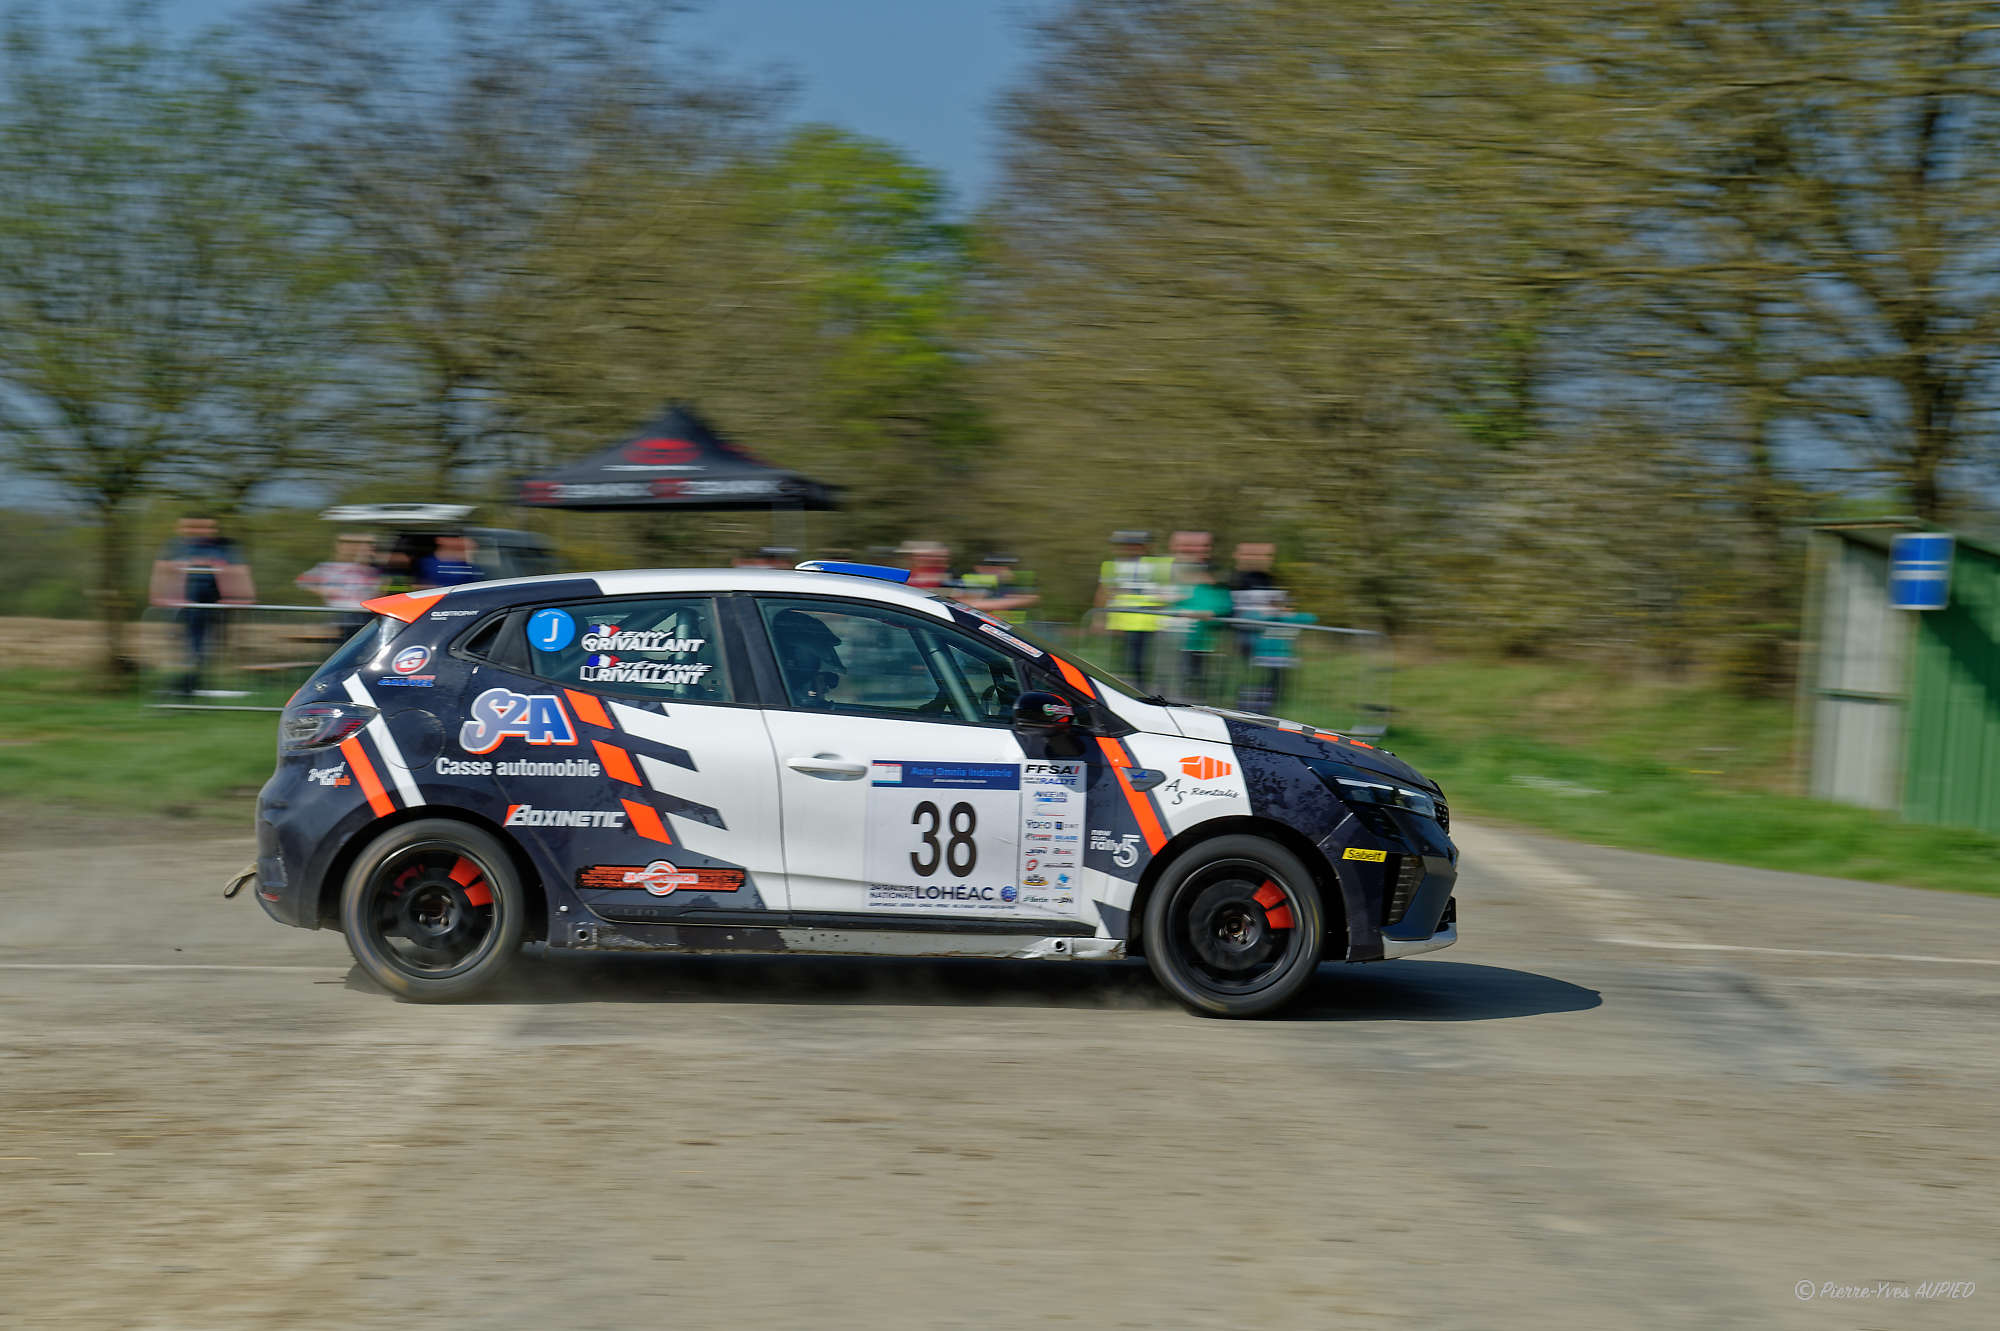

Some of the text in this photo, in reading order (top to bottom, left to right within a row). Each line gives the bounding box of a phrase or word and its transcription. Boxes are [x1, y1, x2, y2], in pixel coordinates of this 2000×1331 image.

[543, 618, 559, 642] J
[598, 638, 705, 652] RIVALLANT
[598, 668, 705, 685] RIVALLANT
[459, 687, 579, 755] S2A
[435, 757, 600, 777] Casse automobile
[910, 767, 933, 775] Auto
[1026, 764, 1074, 775] FFSA
[910, 800, 978, 878] 38
[916, 884, 994, 900] LOHÉAC
